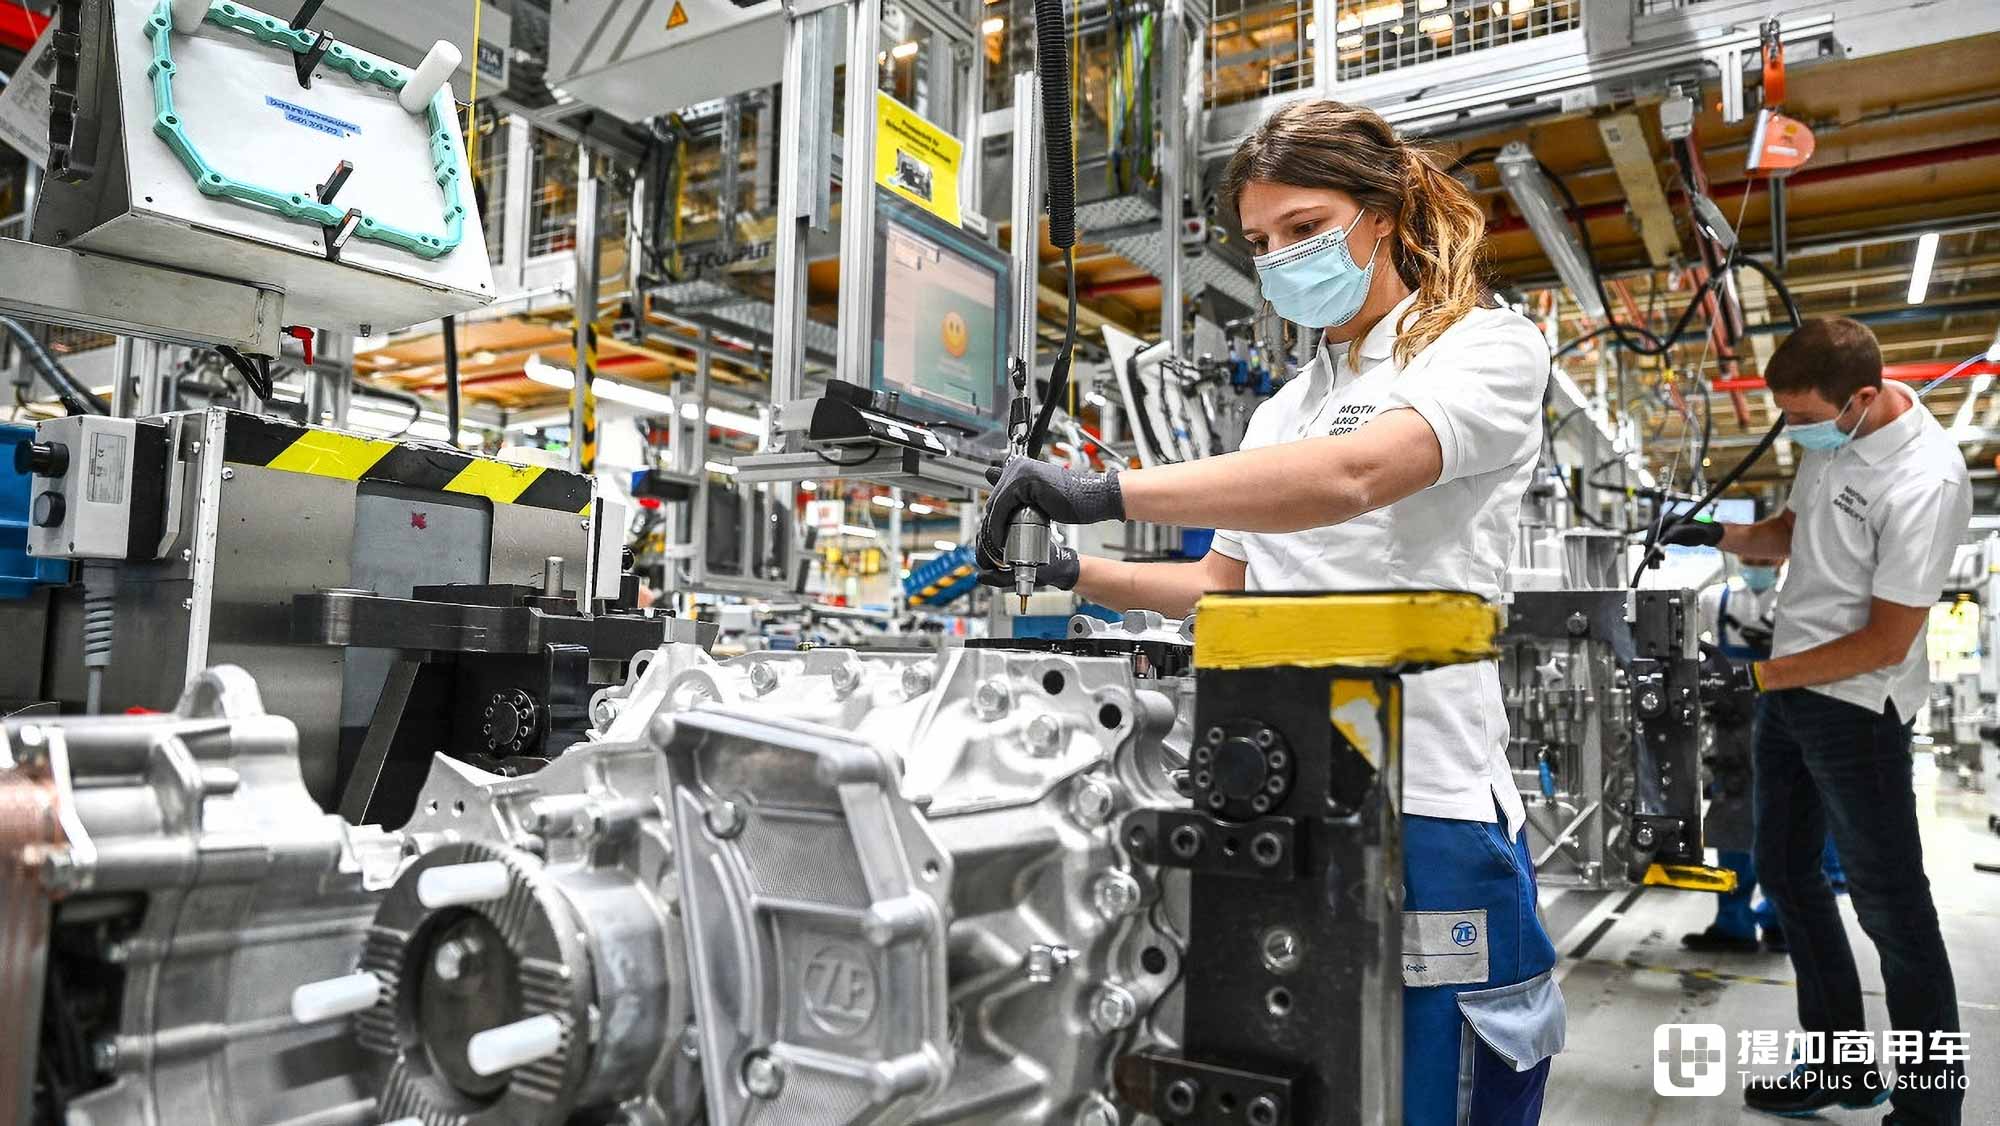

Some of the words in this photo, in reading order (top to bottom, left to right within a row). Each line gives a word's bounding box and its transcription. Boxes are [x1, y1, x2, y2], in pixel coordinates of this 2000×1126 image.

[1331, 416, 1359, 425] AND
[1452, 923, 1477, 945] ZF
[805, 954, 874, 1020] ZF
